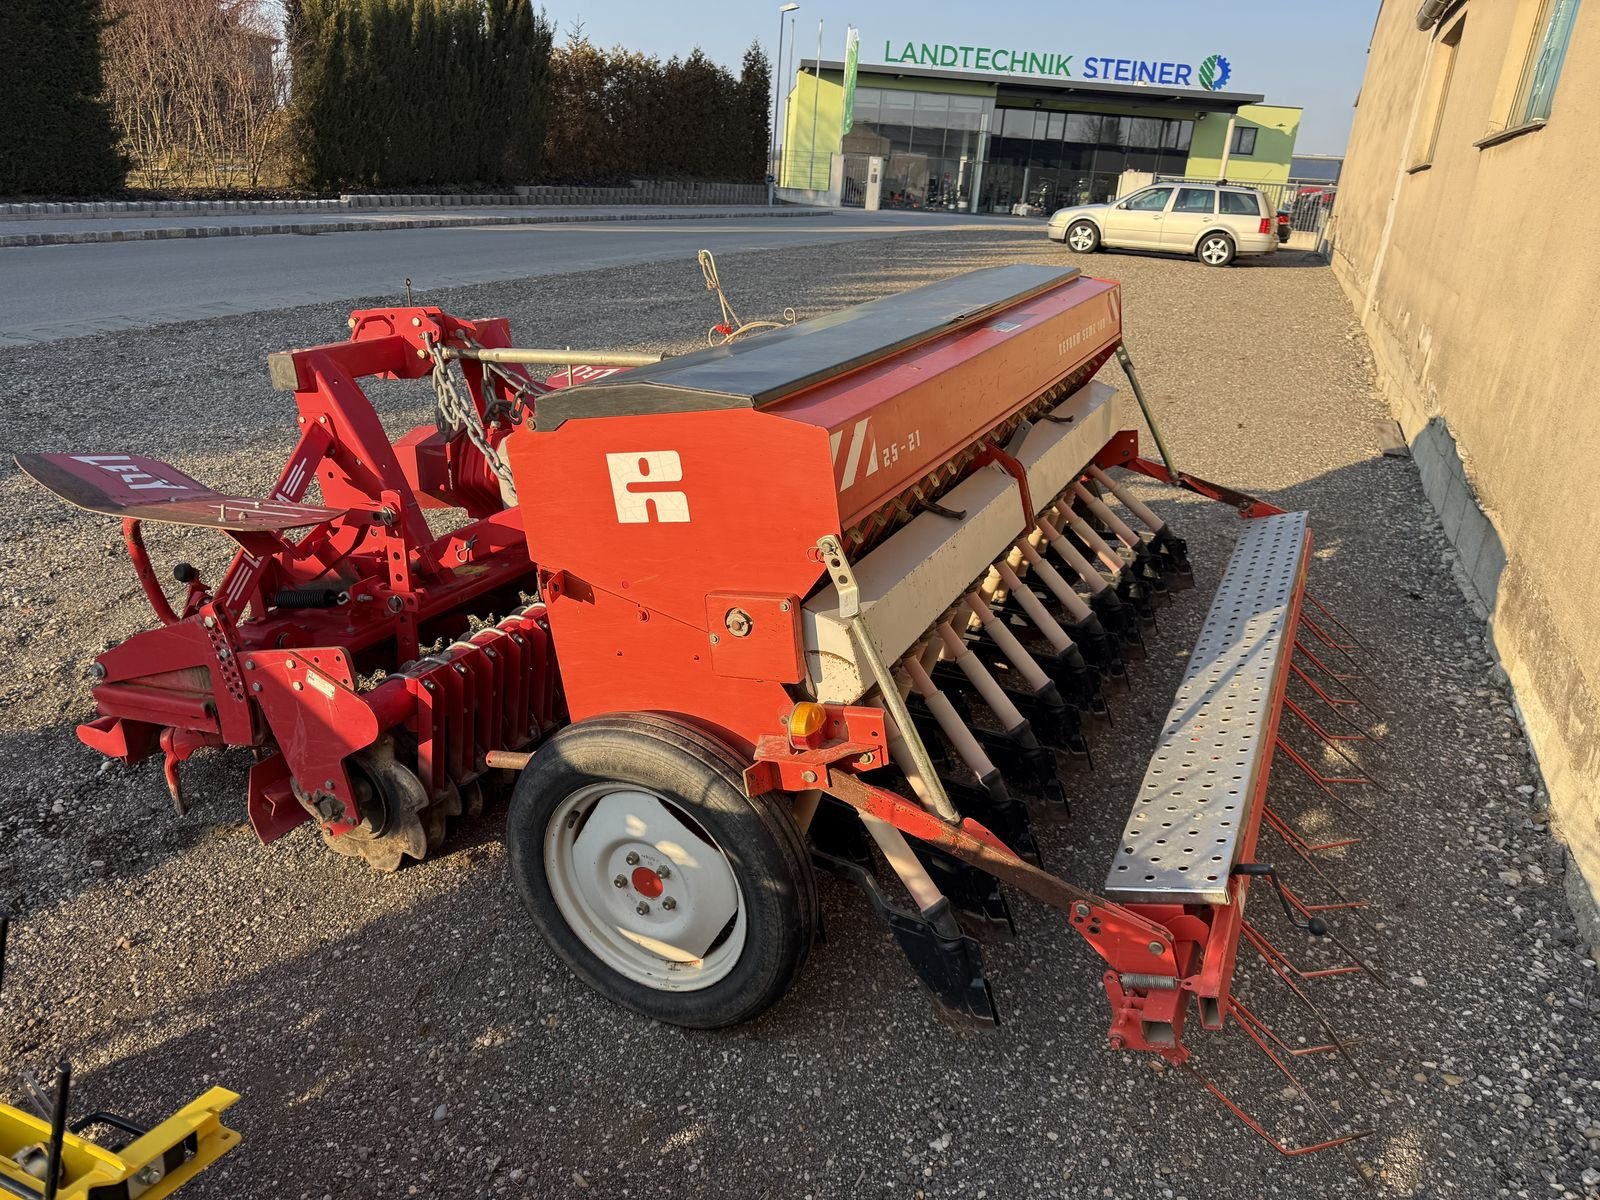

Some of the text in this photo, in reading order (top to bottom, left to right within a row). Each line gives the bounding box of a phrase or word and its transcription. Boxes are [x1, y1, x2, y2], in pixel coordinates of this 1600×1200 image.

[884, 40, 1192, 86] LANDTECHNIK STEINER
[69, 455, 190, 490] LELY
